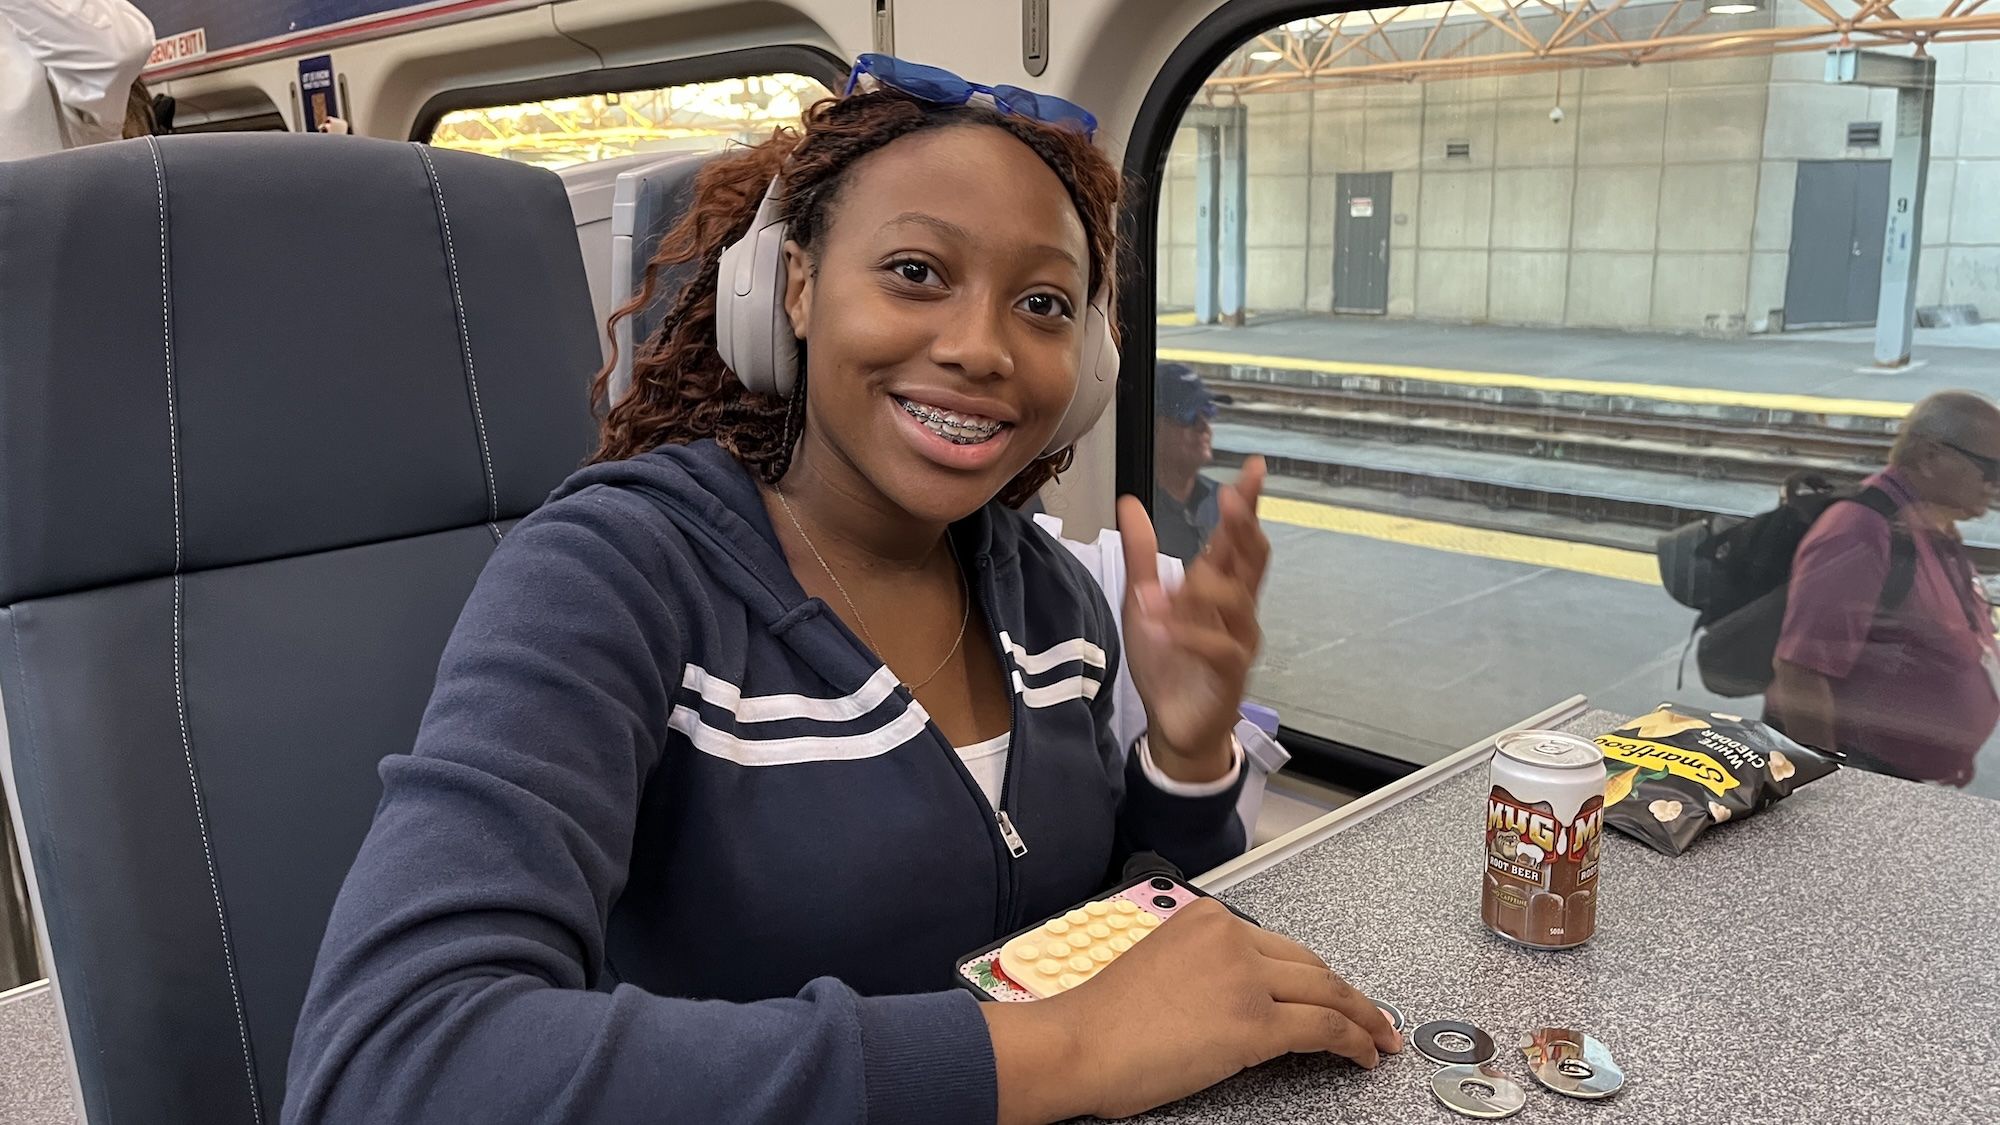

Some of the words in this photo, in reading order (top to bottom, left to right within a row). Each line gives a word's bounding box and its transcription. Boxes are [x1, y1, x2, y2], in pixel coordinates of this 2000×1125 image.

[180, 33, 197, 56] EXIT
[1897, 198, 1907, 213] 9
[1698, 737, 1744, 770] WHITE
[1701, 729, 1765, 769] CHEDDAR
[1488, 800, 1555, 853] MUG
[1490, 856, 1509, 871] ROOT
[1511, 864, 1539, 881] BEER
[1550, 927, 1564, 935] SODA
